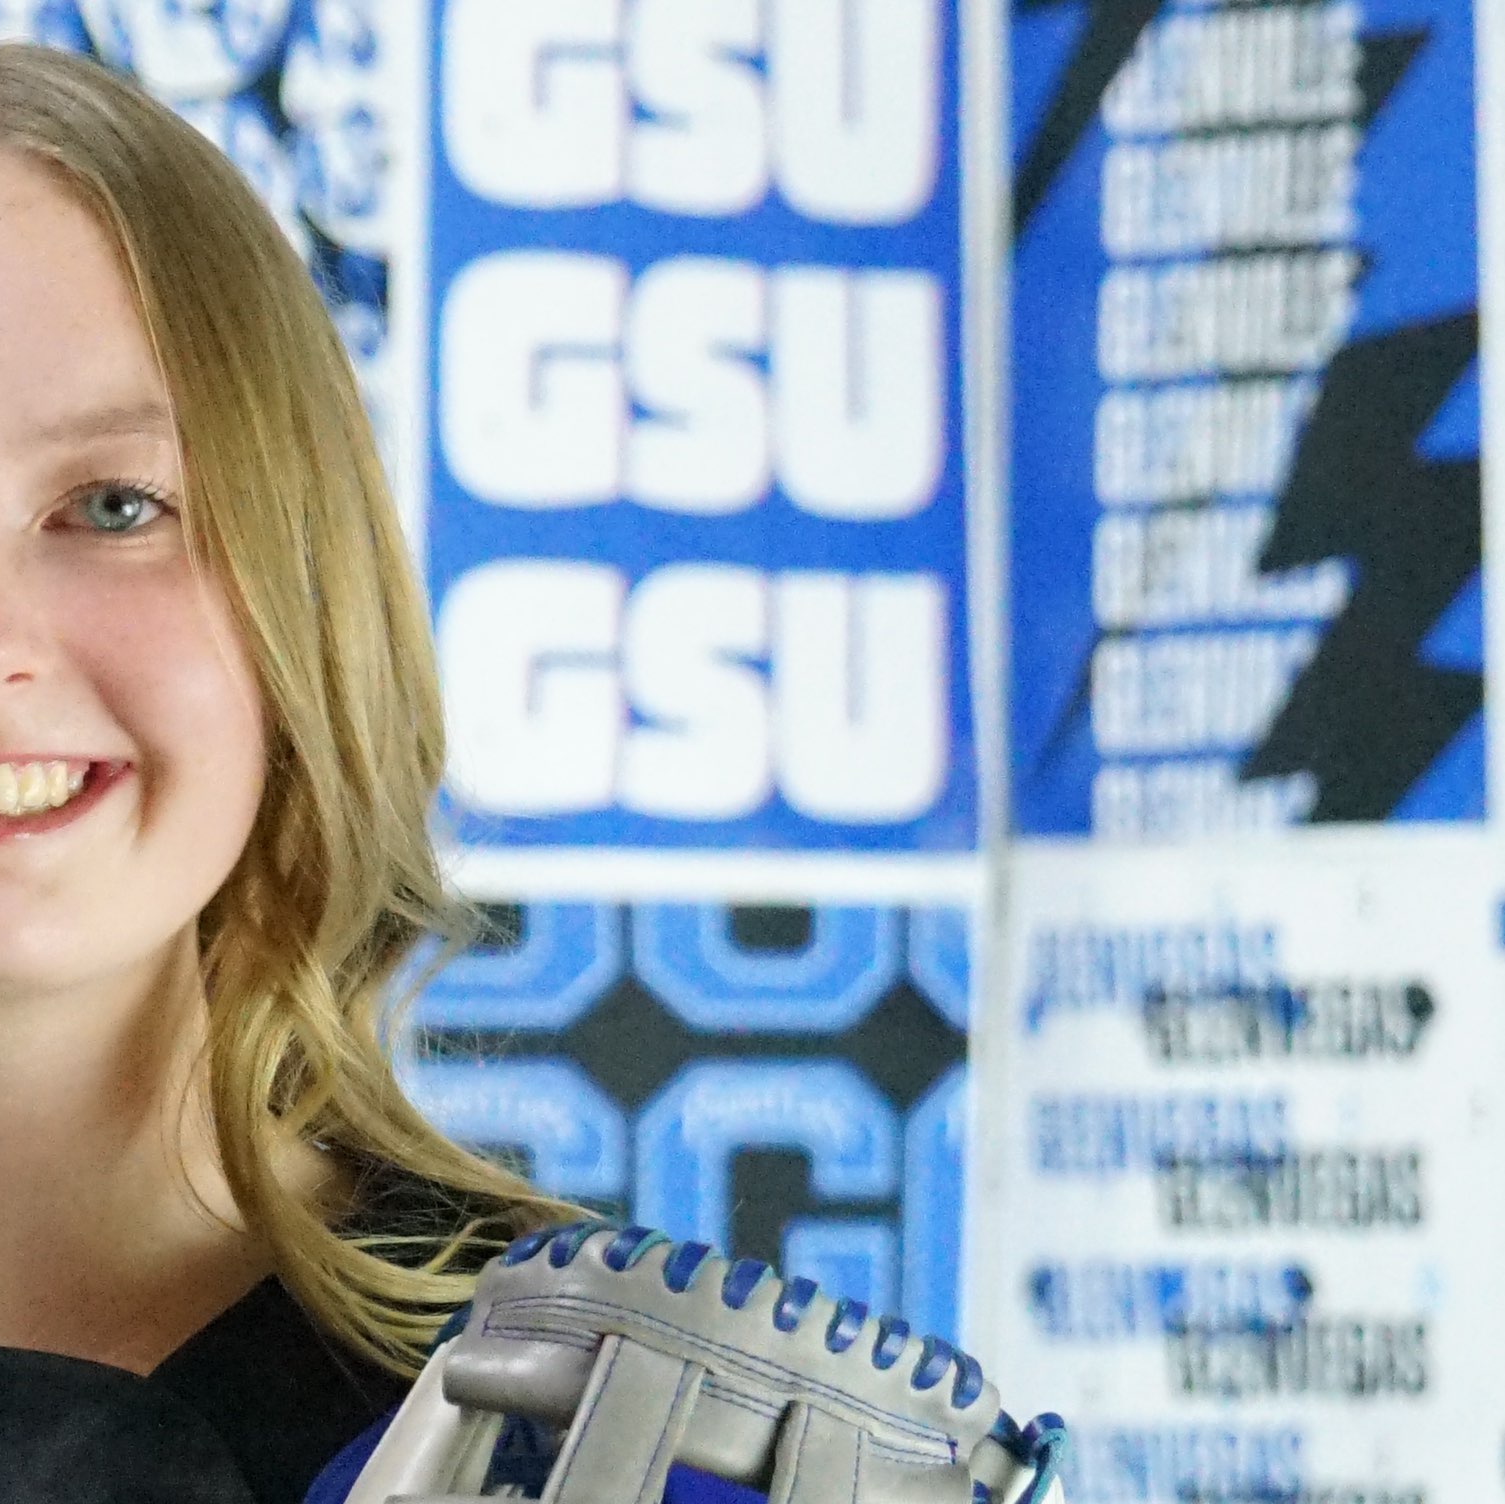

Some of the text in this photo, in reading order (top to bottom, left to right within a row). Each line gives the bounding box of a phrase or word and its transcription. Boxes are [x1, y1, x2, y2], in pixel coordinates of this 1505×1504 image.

[440, 0, 938, 226] GSU
[439, 250, 947, 520] GSU
[439, 557, 950, 824] GSU
